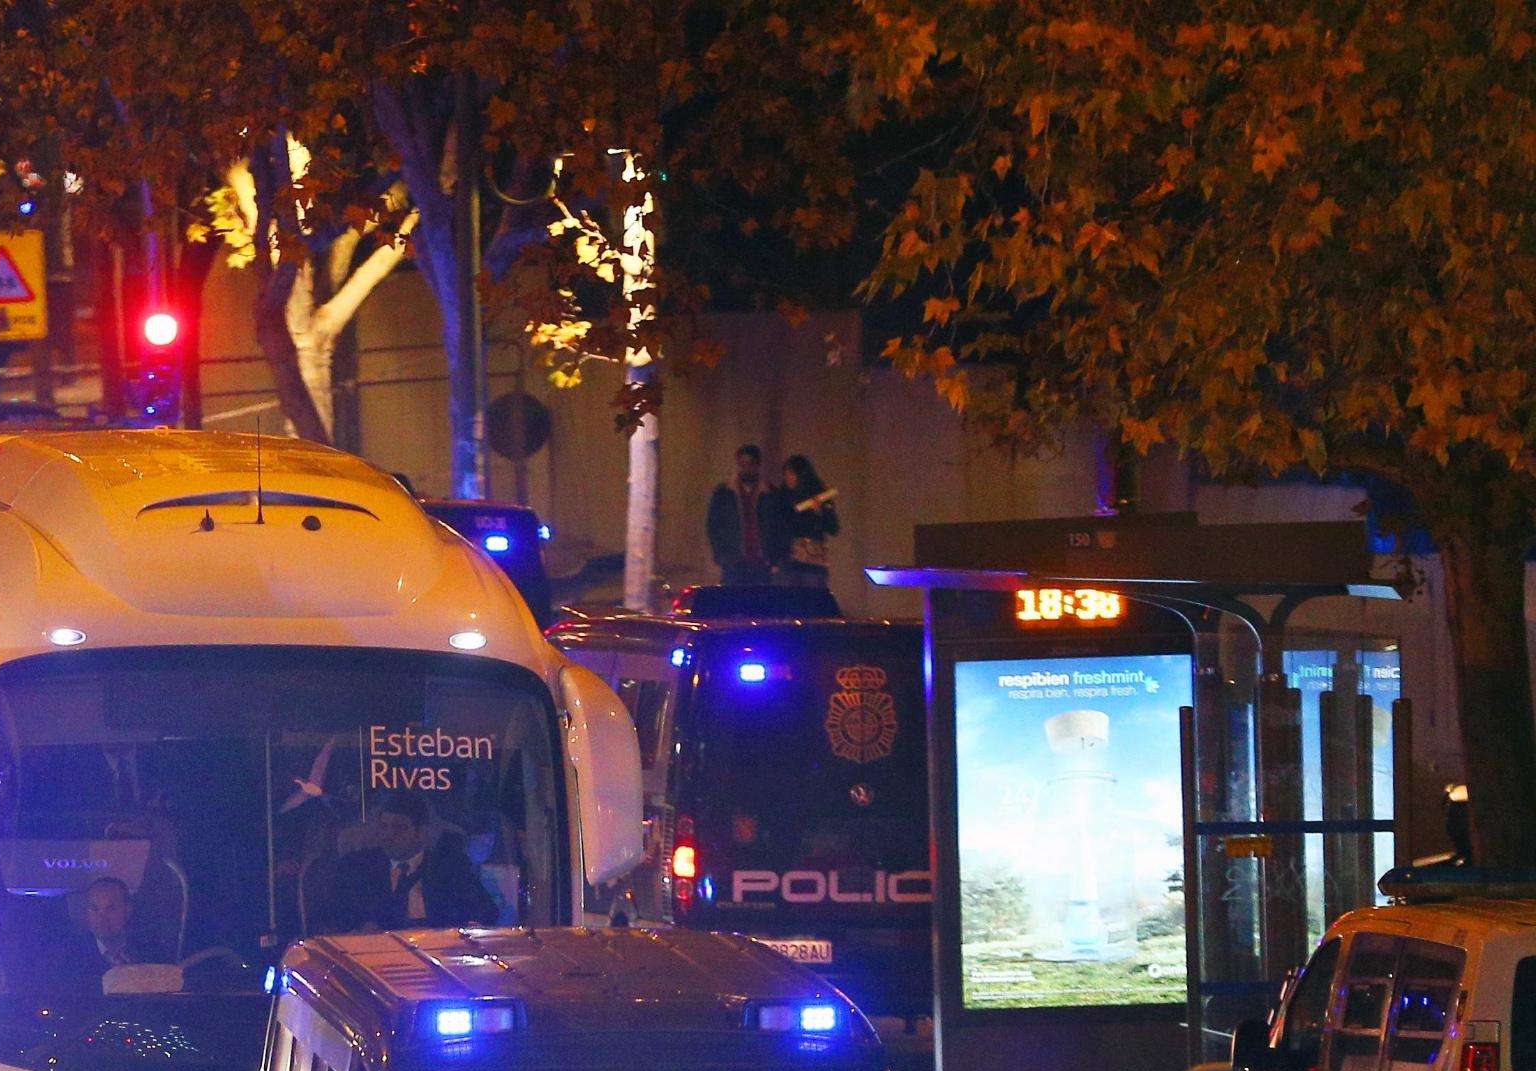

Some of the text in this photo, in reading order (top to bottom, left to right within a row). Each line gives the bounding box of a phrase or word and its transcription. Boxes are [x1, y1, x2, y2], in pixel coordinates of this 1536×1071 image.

[1069, 533, 1090, 547] 150
[998, 670, 1145, 689] respibien freshmint
[1008, 688, 1043, 700] respira
[1073, 687, 1109, 698] respira
[370, 725, 492, 760] Esteban
[370, 758, 452, 790] Rivas
[44, 858, 108, 870] VOLVO
[732, 870, 936, 904] POLIC
